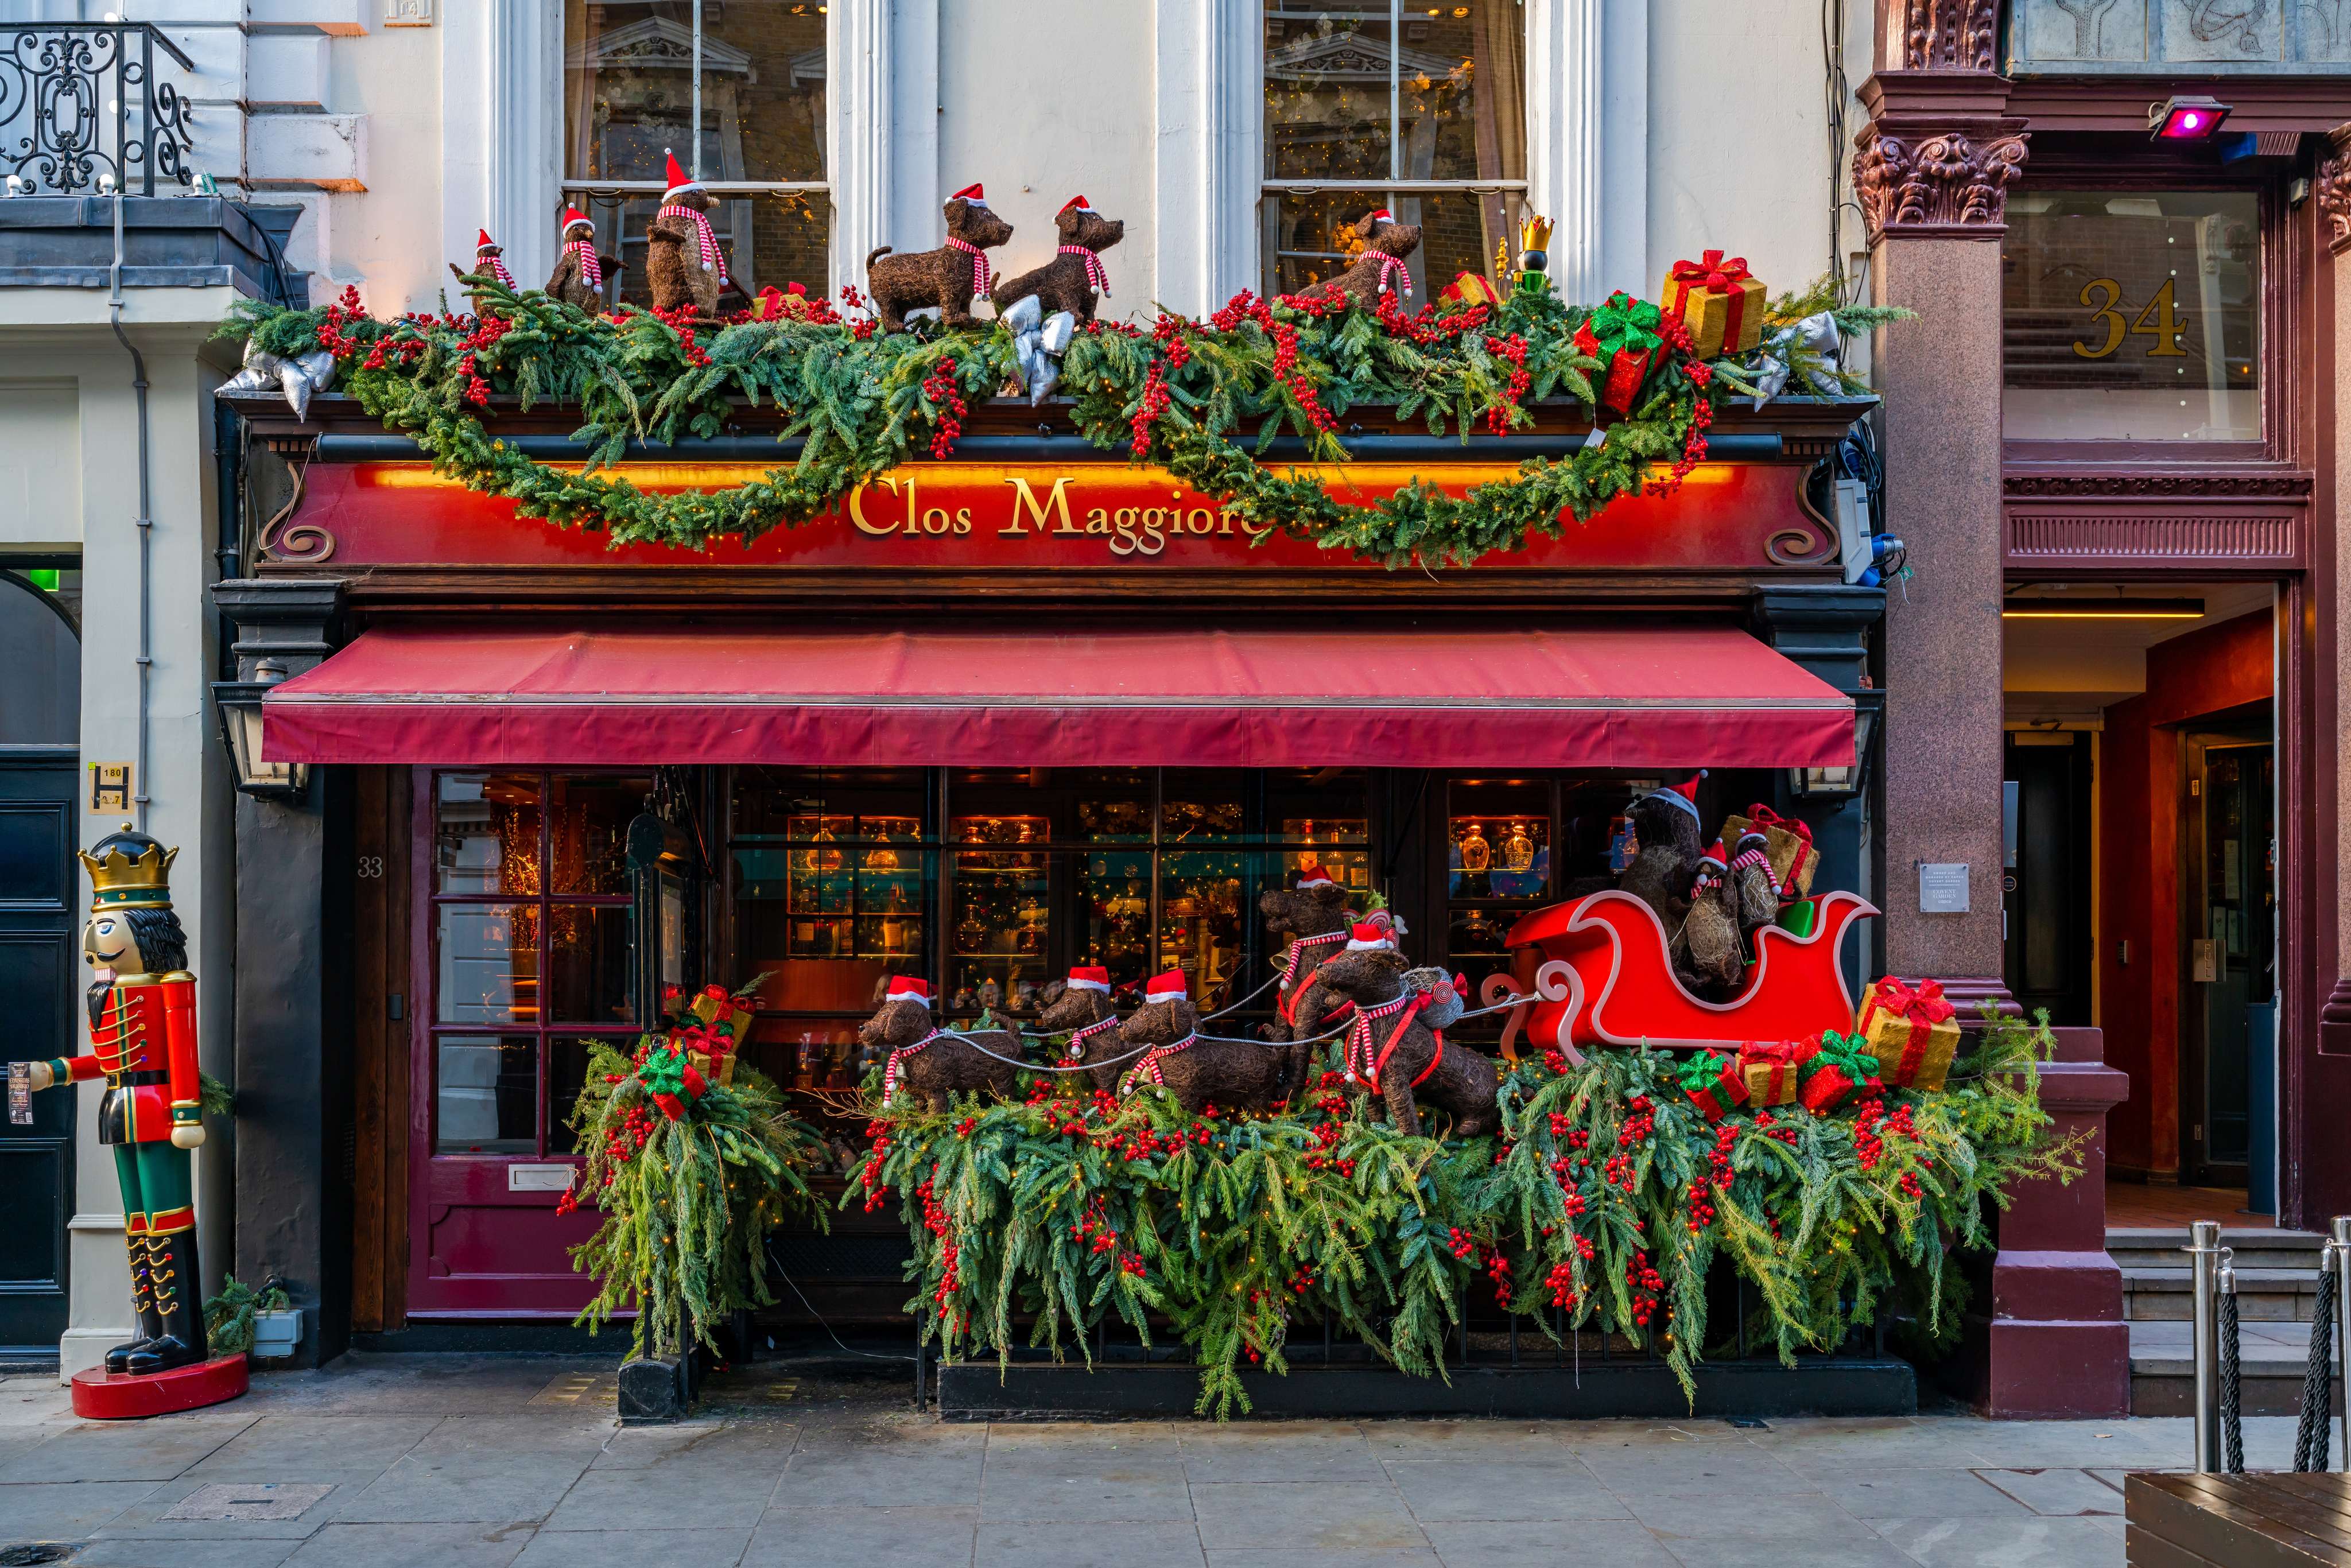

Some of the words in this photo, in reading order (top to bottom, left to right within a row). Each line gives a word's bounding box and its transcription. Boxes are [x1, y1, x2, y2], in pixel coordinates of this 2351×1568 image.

[2072, 278, 2189, 358] 34
[849, 477, 971, 535] Clos
[358, 856, 382, 878] 33
